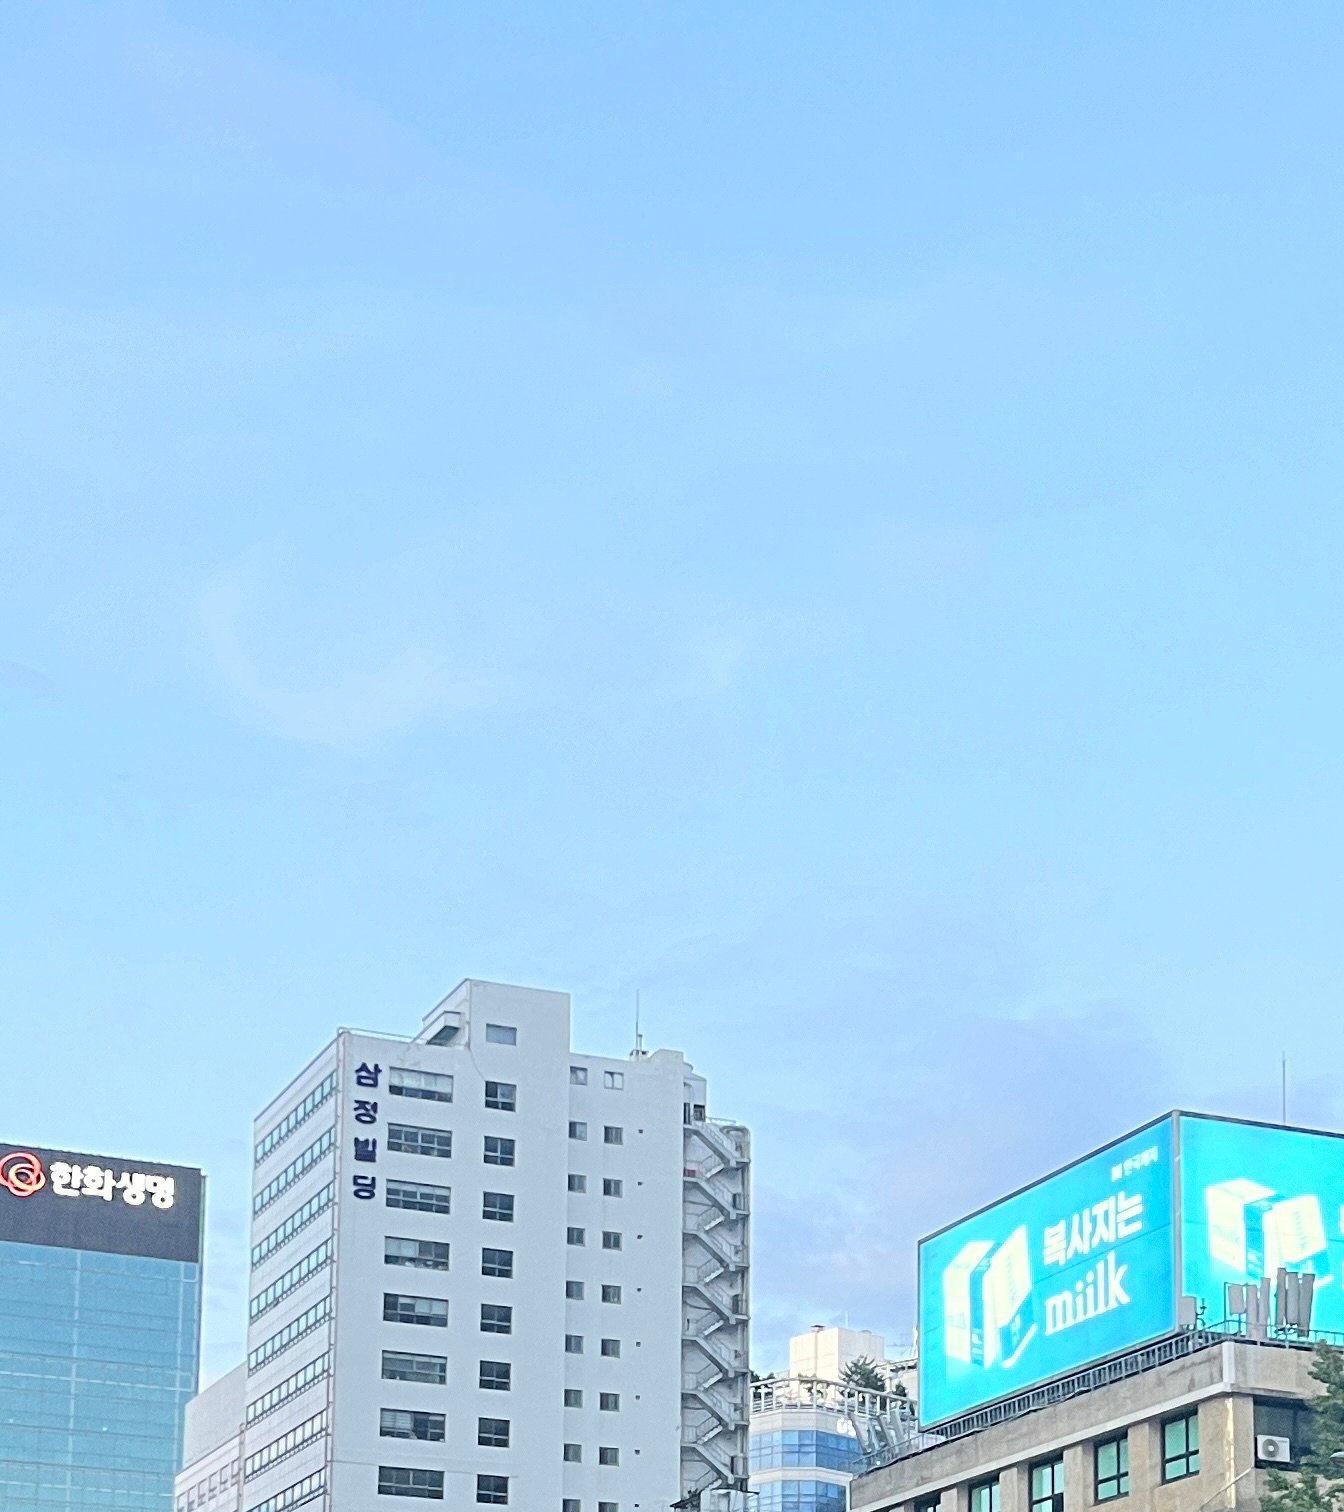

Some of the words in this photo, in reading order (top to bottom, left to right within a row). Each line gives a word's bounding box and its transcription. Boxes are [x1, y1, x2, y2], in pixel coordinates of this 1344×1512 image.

[353, 1062, 382, 1200] 삼정빌딩
[49, 1161, 175, 1209] 한화생명
[1043, 1191, 1144, 1266] 복사지는
